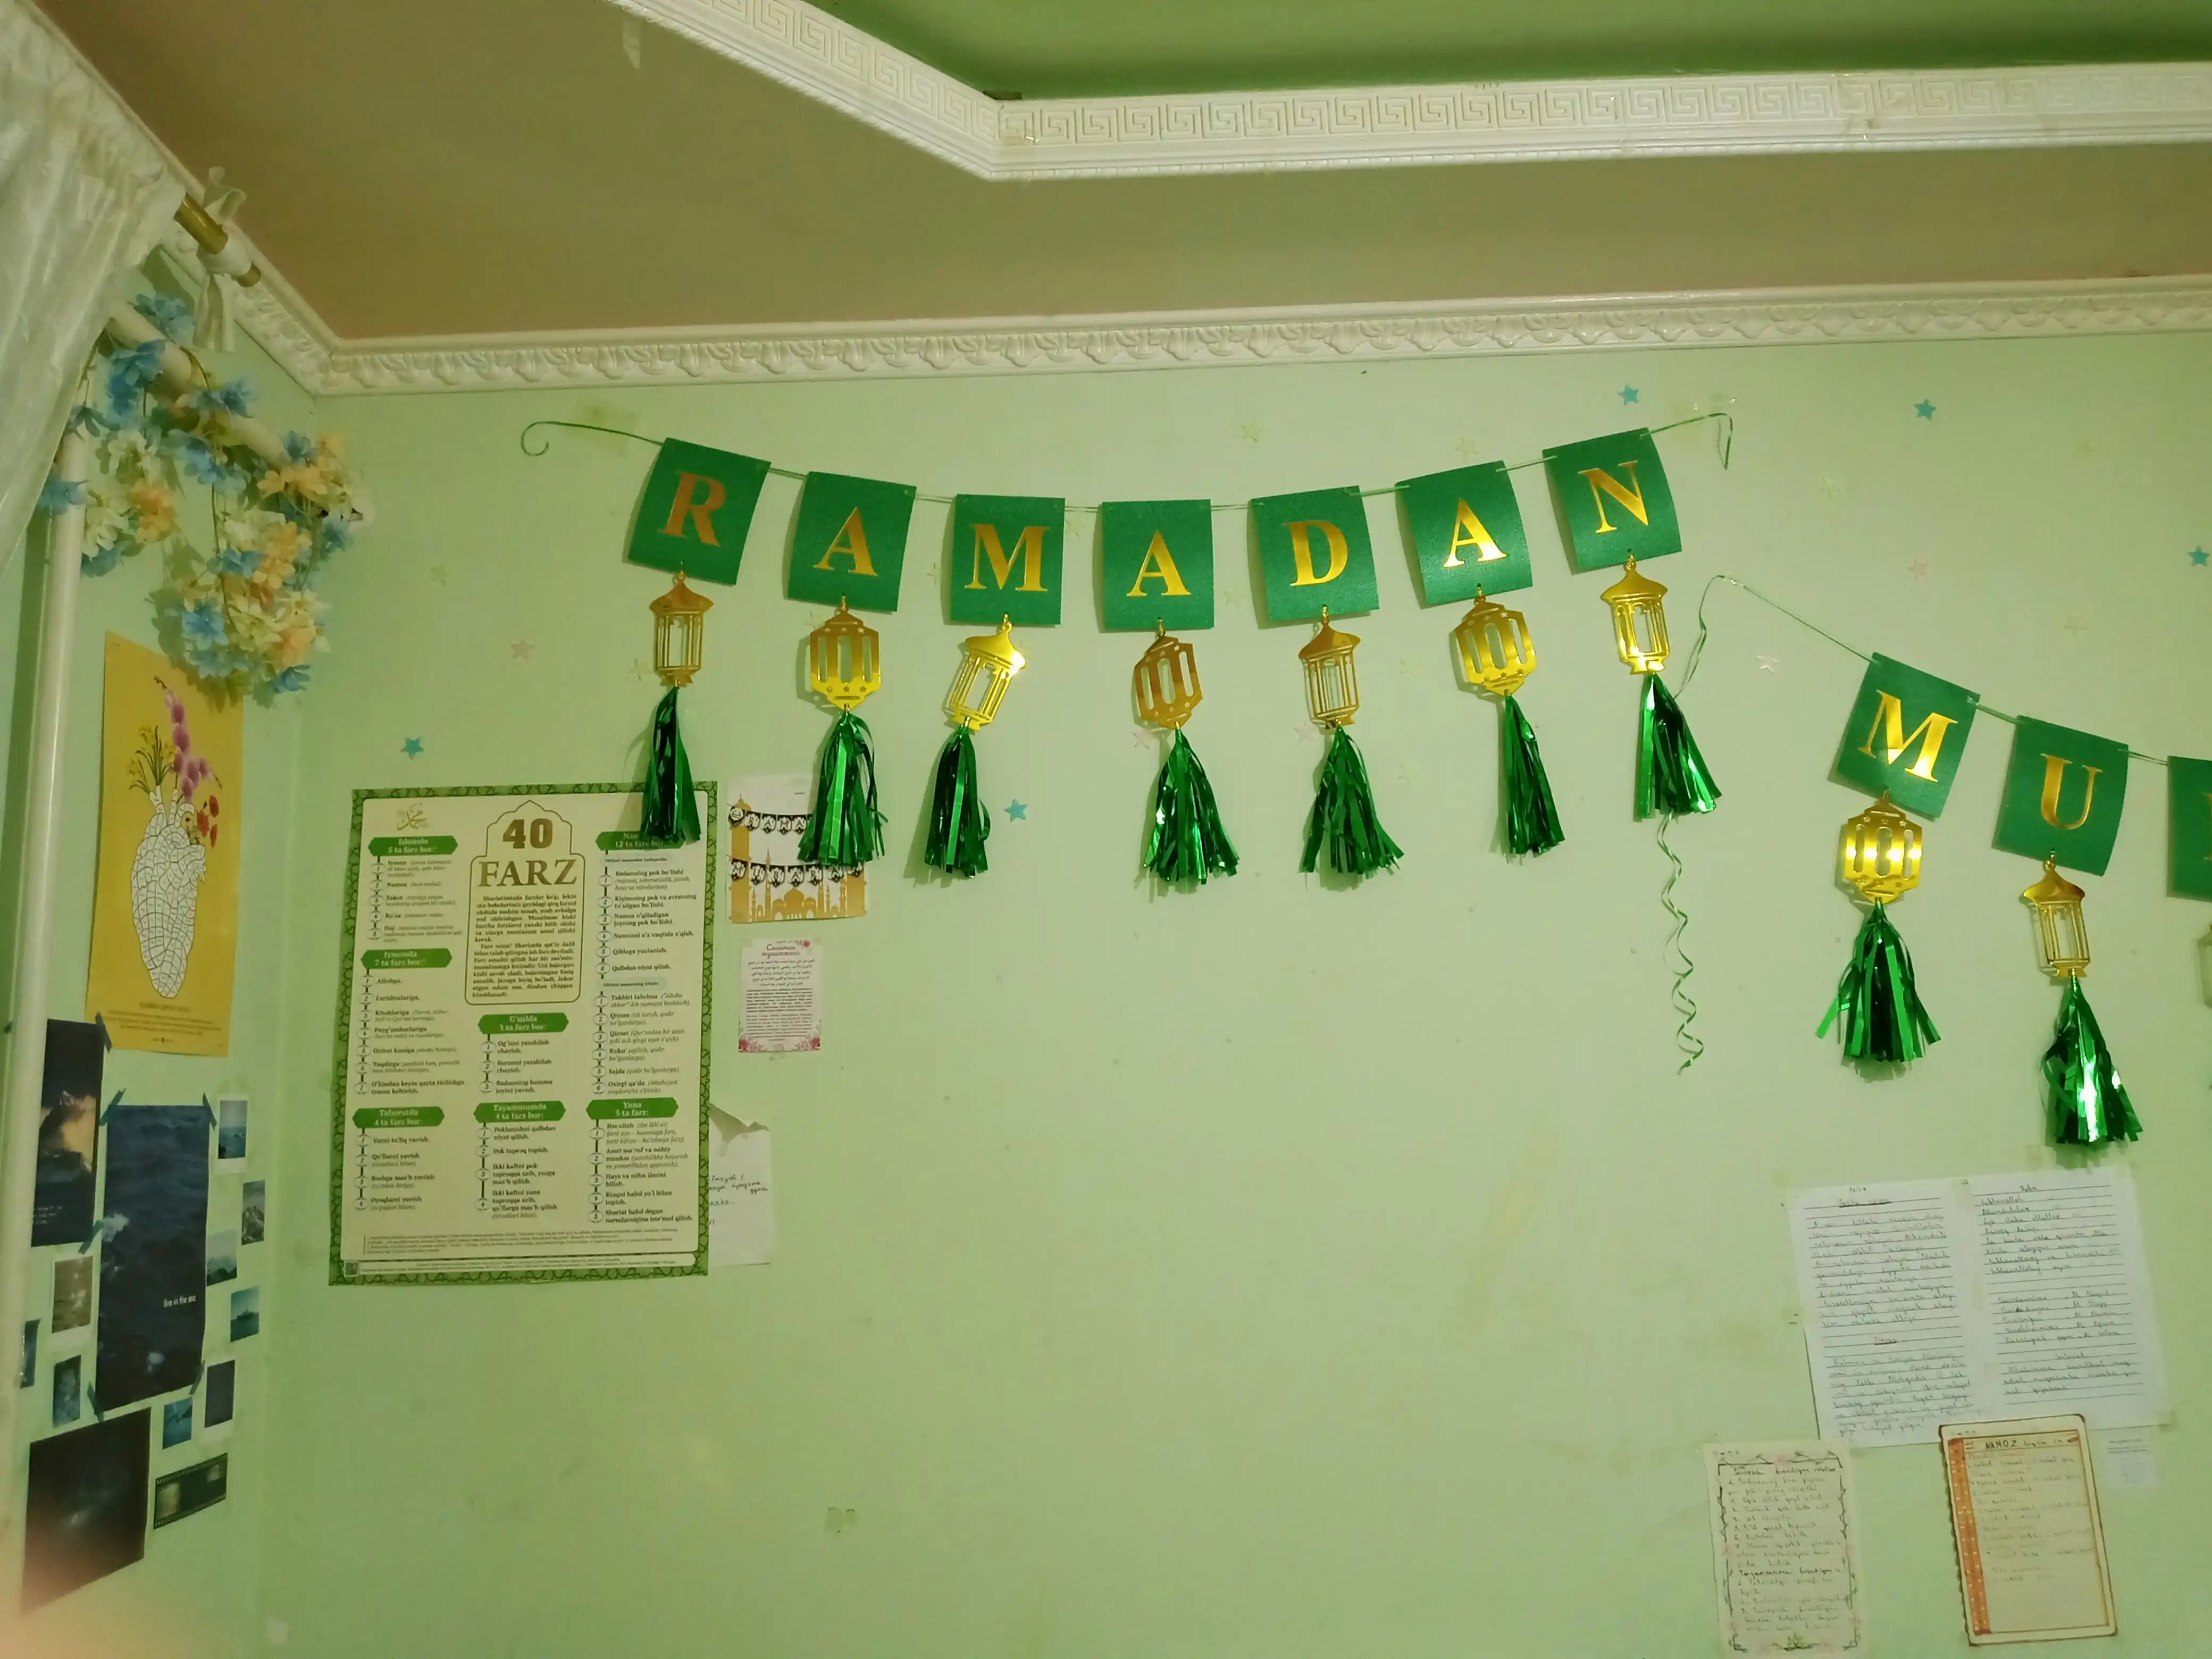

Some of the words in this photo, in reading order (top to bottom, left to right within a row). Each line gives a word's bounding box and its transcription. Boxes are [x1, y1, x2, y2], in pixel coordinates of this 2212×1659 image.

[658, 460, 1649, 596] RAMADAN
[502, 818, 553, 849] 40
[478, 859, 577, 887] FARZ
[1985, 1439, 2017, 1450] NAMOZ
